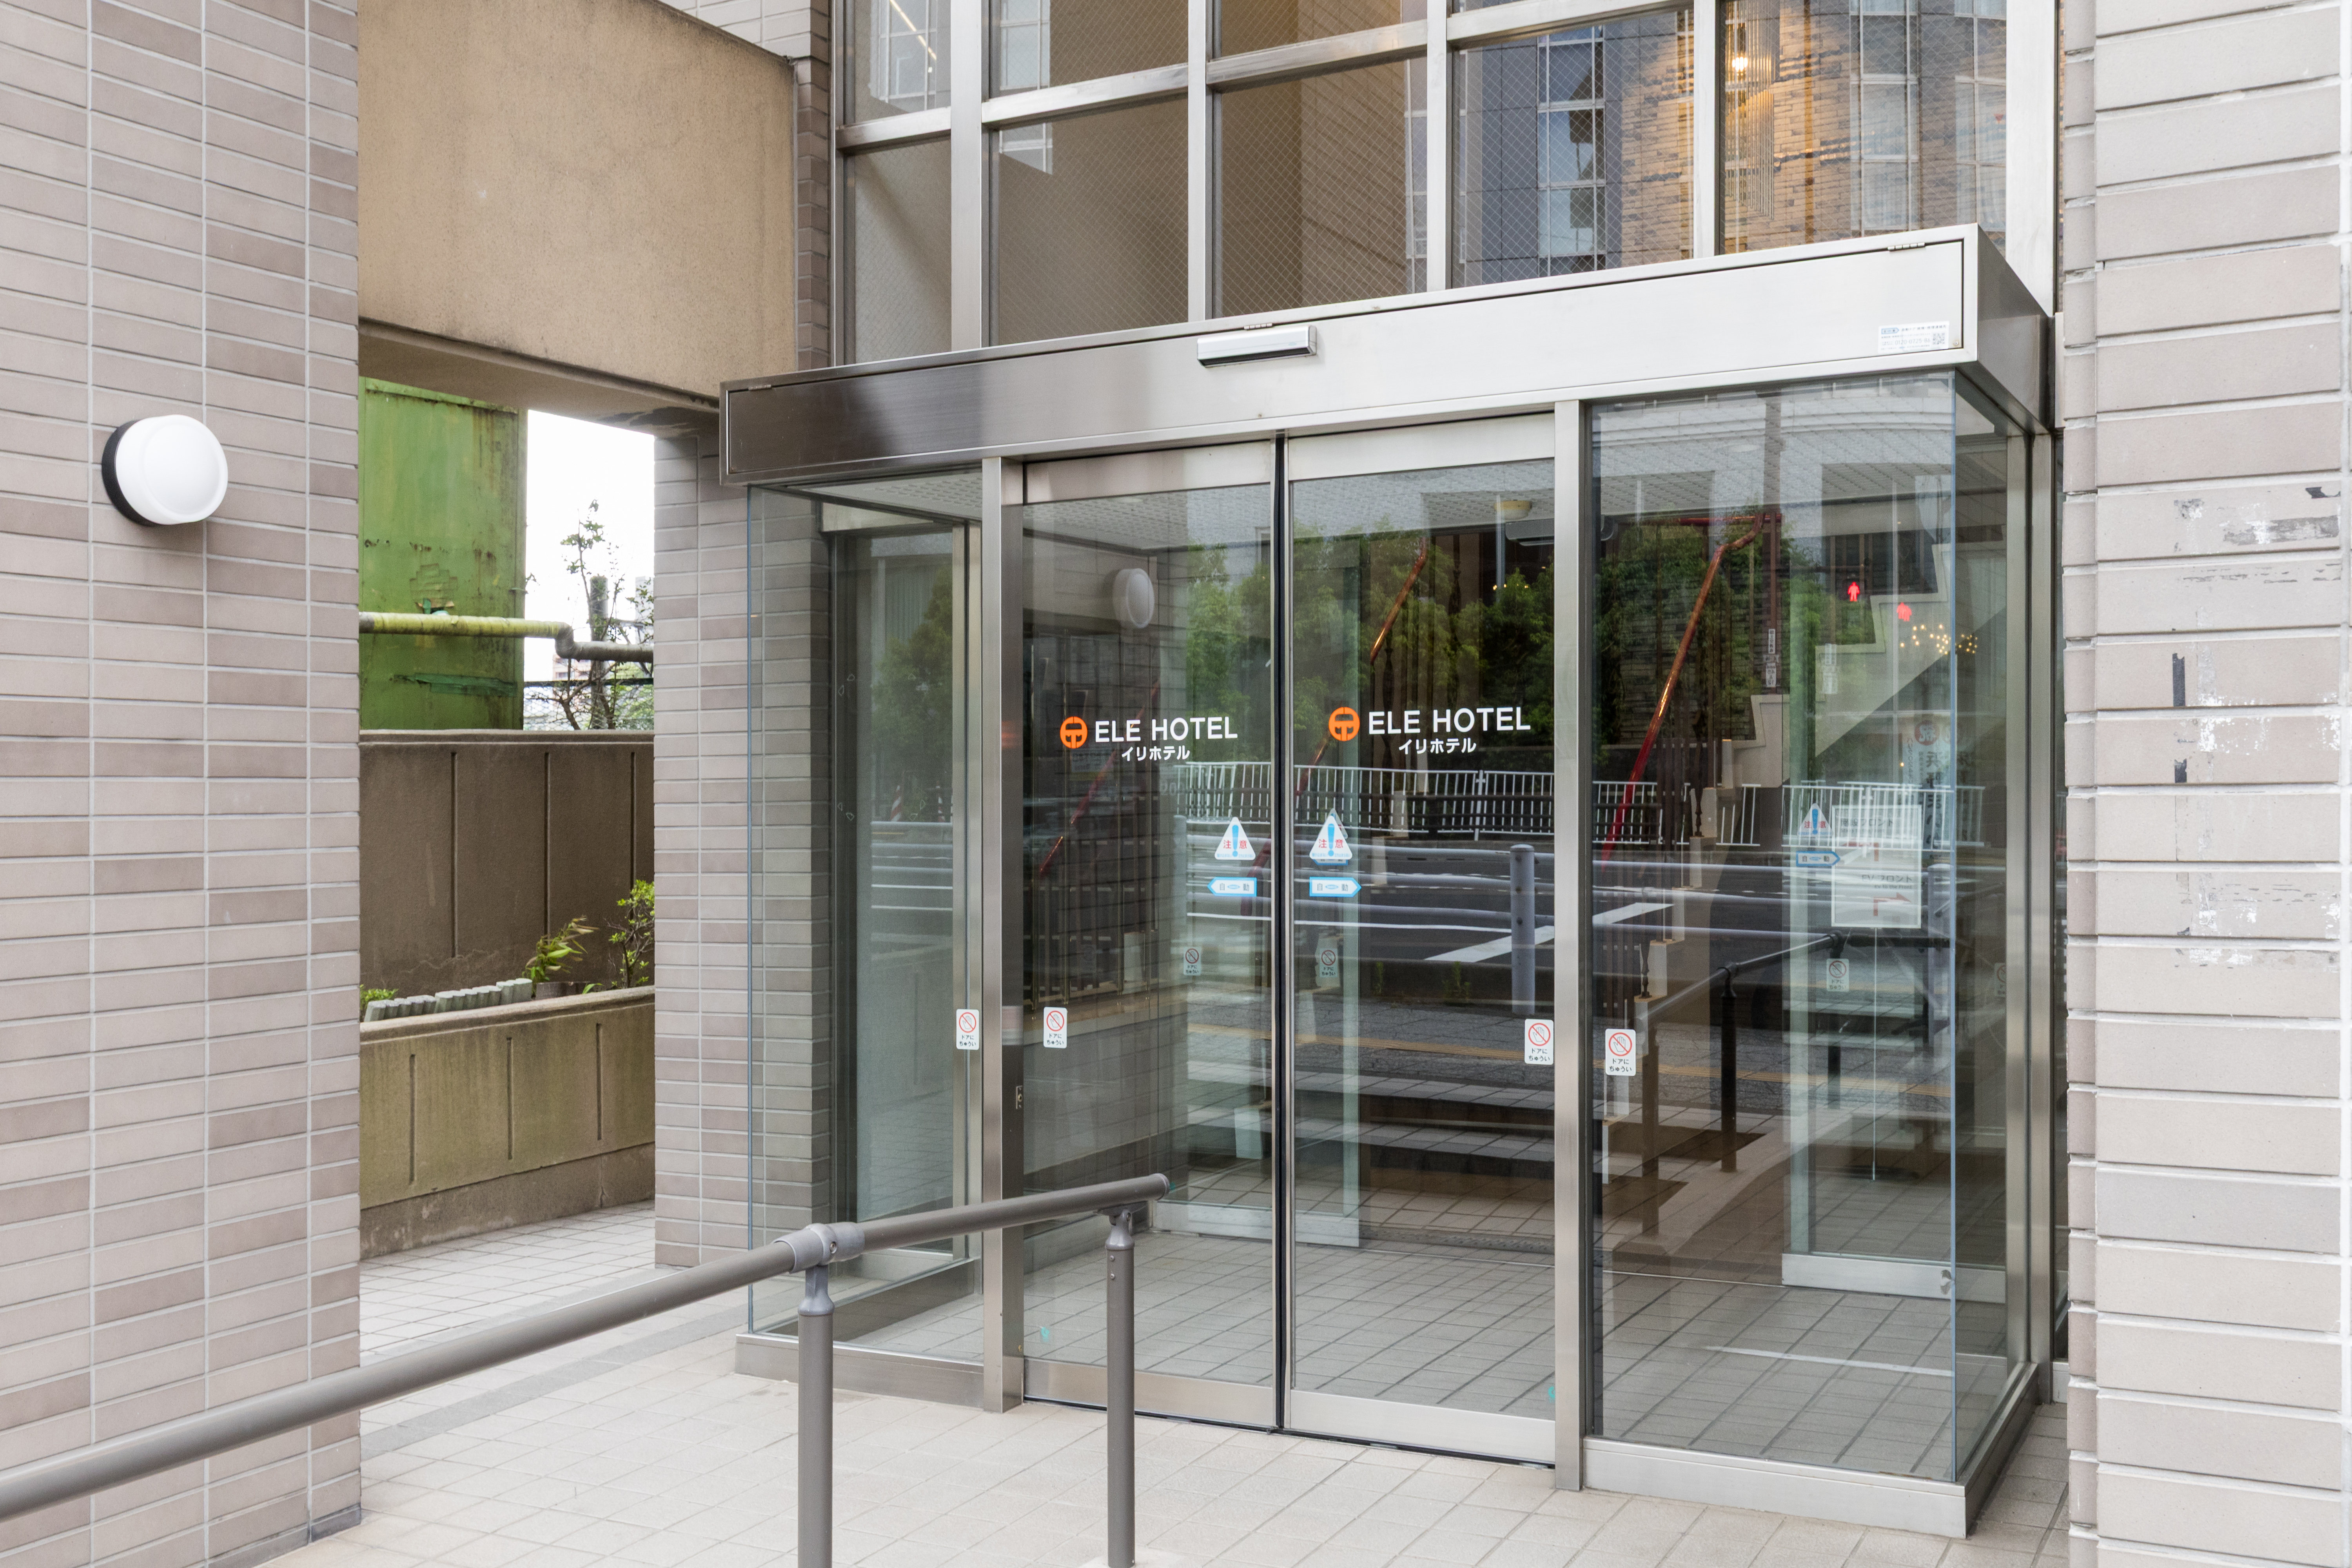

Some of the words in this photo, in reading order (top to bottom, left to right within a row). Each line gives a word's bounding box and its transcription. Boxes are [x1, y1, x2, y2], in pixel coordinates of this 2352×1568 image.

[1368, 710, 1421, 735] ELE
[1433, 707, 1531, 733] HOTEL
[1095, 719, 1141, 742] ELE
[1152, 716, 1238, 741] HOTEL
[1398, 738, 1477, 755] イリホテル
[1122, 745, 1191, 761] イリホテル
[1223, 840, 1247, 849] 注意
[1319, 839, 1343, 848] 注意
[1220, 883, 1249, 891] 自動
[1317, 883, 1348, 891] 自動
